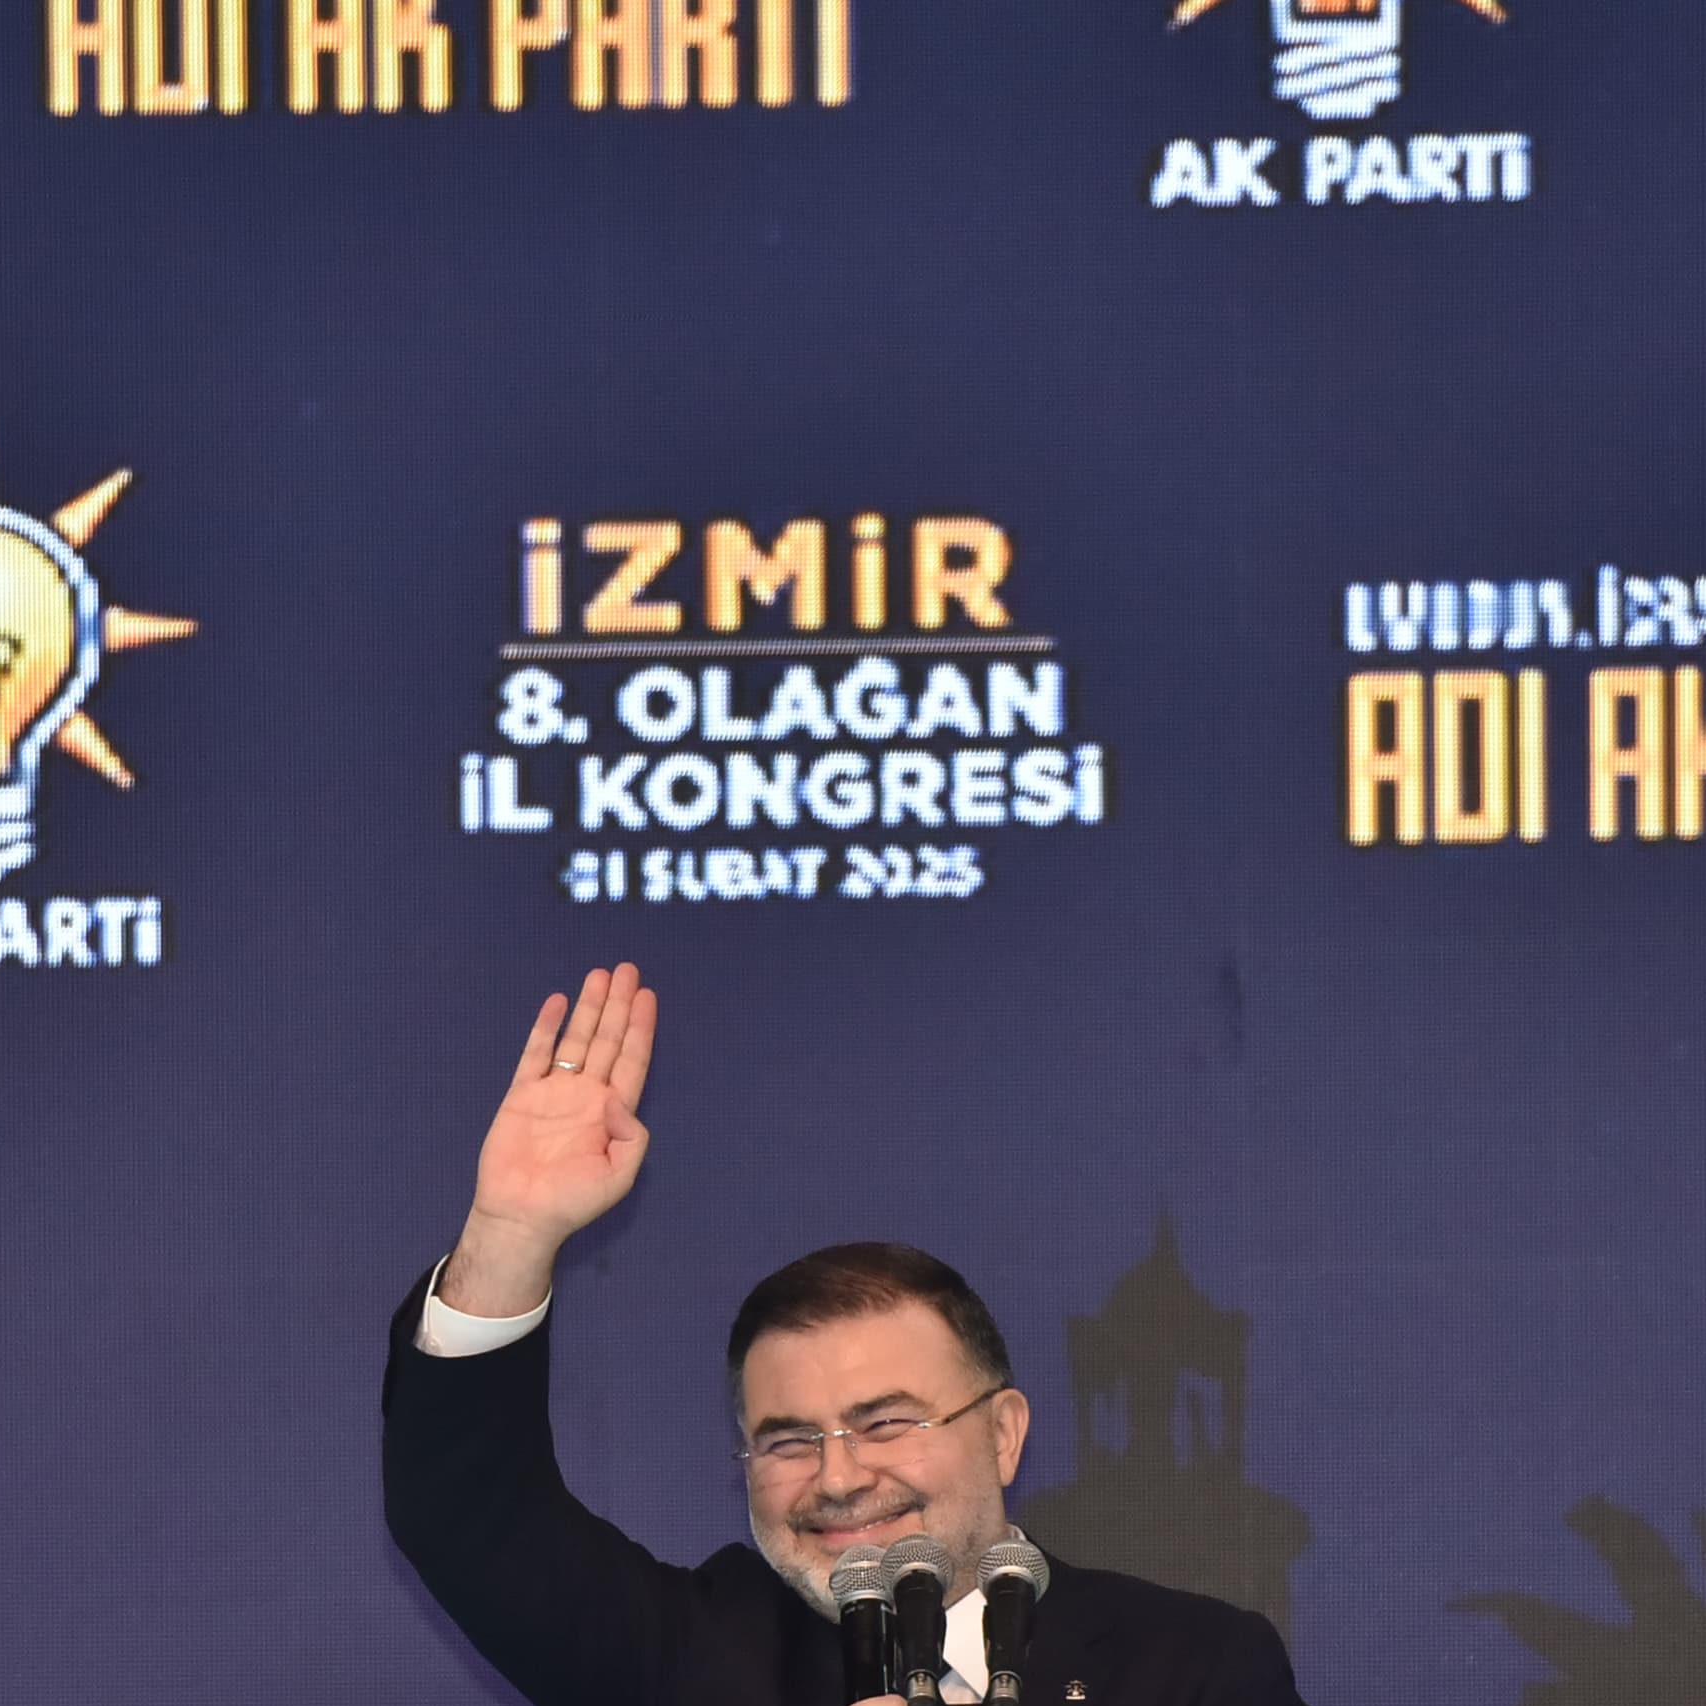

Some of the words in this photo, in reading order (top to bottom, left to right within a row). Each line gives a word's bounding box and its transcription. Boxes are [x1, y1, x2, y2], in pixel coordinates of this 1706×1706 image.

[1150, 138, 1280, 208] AK
[521, 512, 1013, 634] İZMİR
[617, 656, 1063, 742] OLAĞAN
[460, 751, 553, 833] İL
[578, 744, 1104, 831] KONGRESİ
[1347, 668, 1546, 845] ADI
